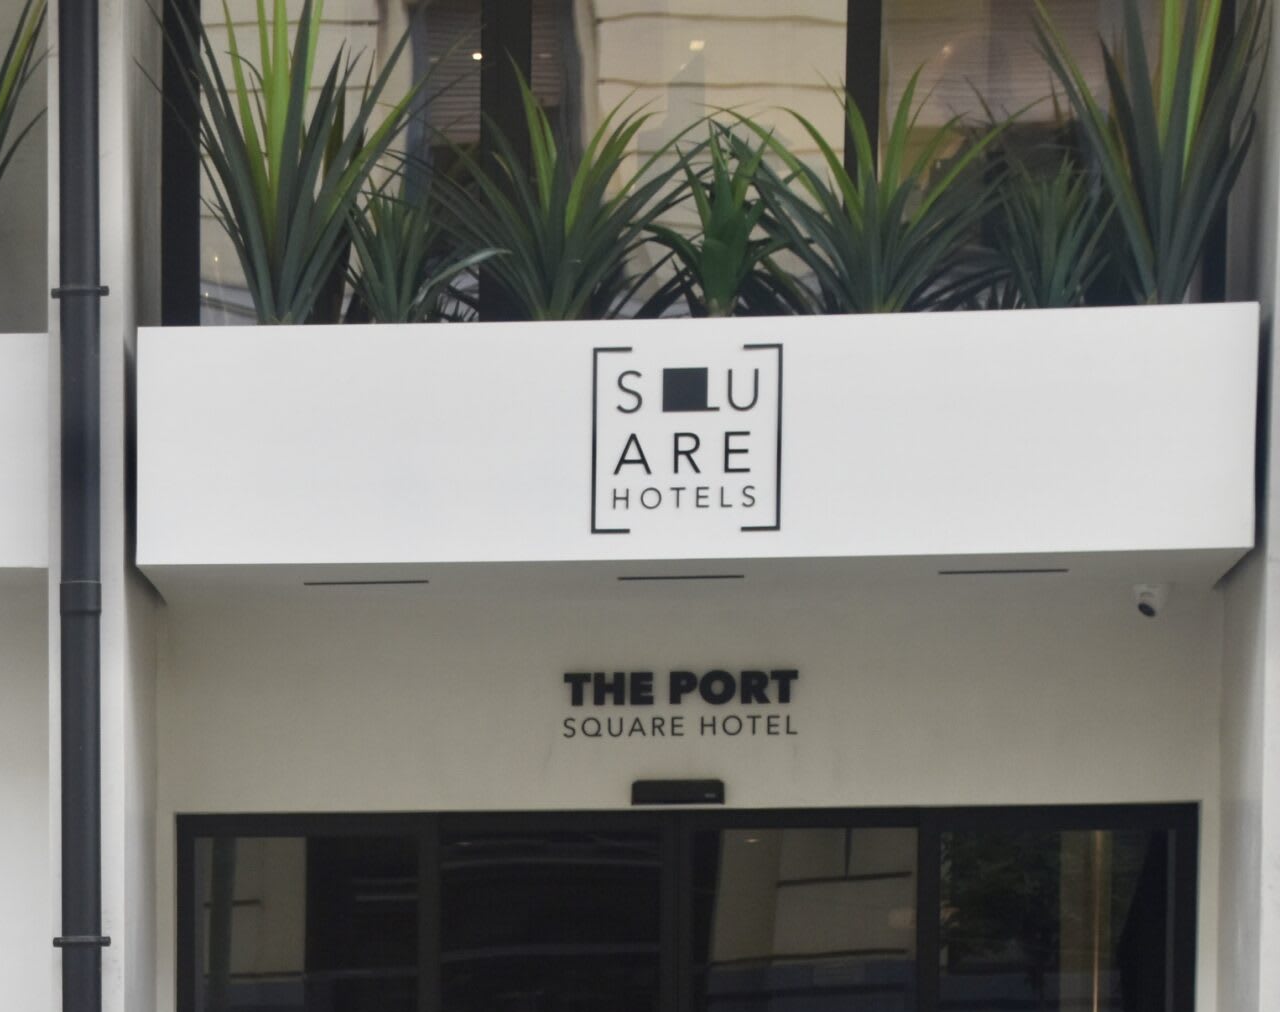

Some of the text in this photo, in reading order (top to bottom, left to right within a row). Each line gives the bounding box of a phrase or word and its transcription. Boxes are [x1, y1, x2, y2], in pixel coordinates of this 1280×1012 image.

[613, 431, 751, 475] ARE
[612, 485, 756, 510] HOTELS
[563, 669, 799, 706] THE PORT
[563, 715, 799, 738] SQUARE HOTEL
